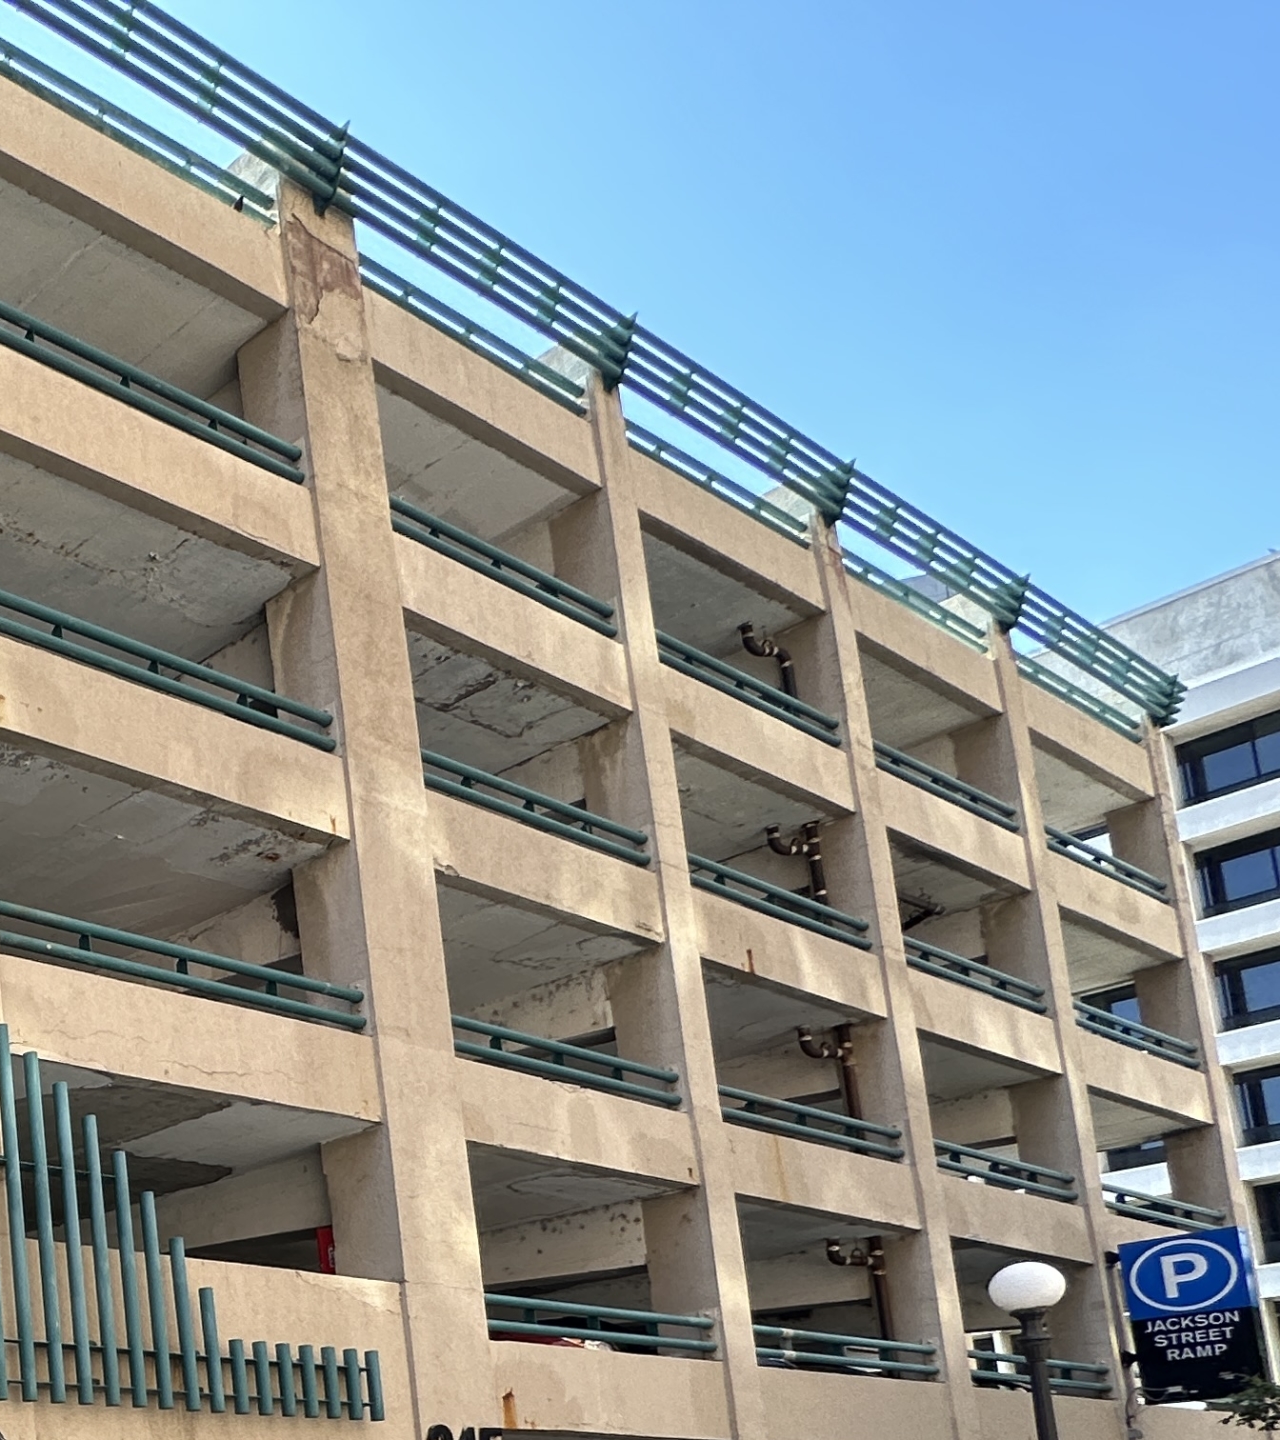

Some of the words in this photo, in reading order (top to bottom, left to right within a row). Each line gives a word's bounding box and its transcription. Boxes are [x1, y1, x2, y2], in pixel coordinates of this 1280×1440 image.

[1160, 1252, 1207, 1298] P
[1144, 1310, 1240, 1334] JACKSON
[1154, 1326, 1235, 1348] STREET
[1166, 1343, 1228, 1362] RAMP
